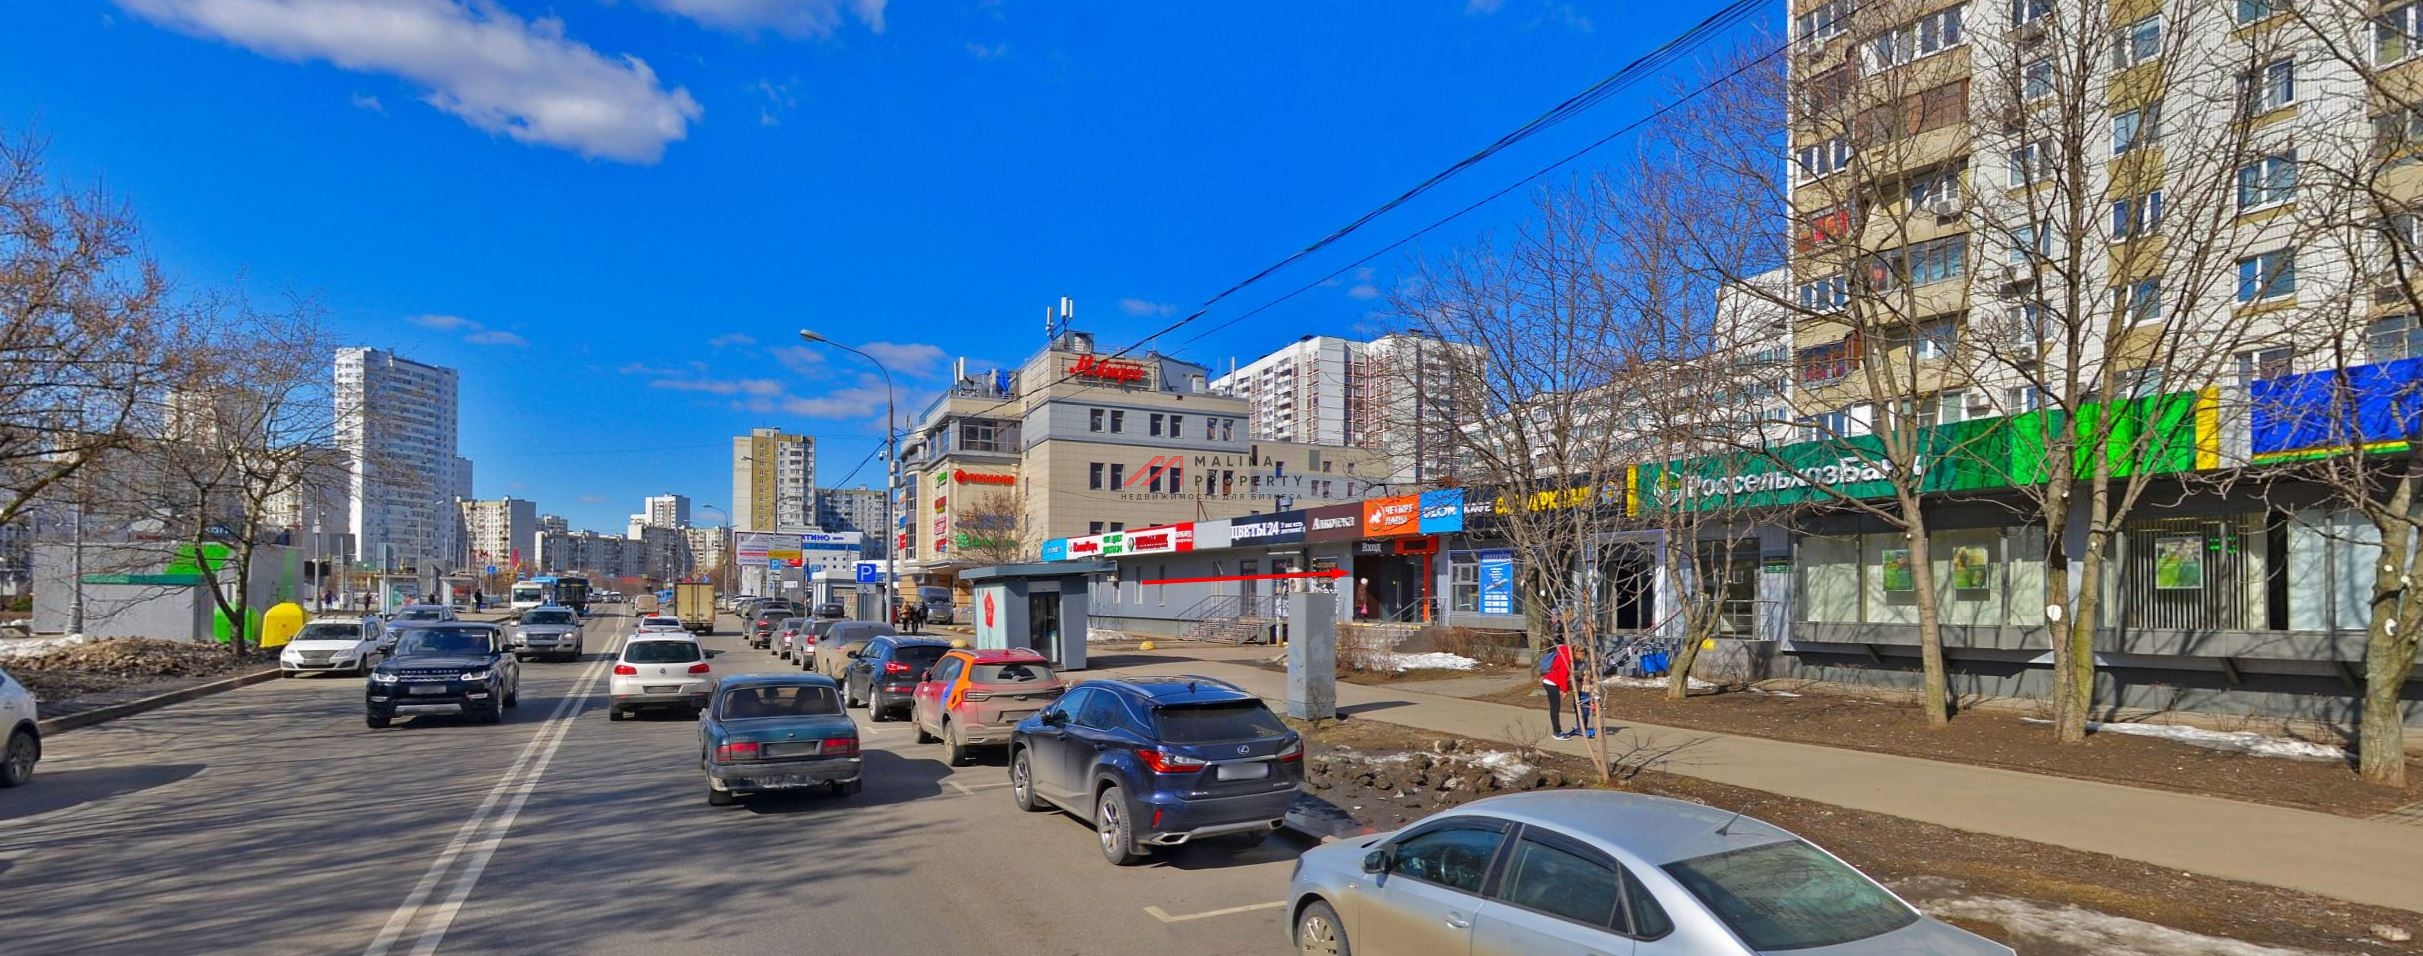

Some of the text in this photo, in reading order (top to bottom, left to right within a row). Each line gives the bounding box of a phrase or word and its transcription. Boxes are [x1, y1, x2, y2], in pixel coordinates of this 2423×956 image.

[1384, 503, 1414, 514] ЧЕТЫРЕ
[1384, 515, 1409, 526] ЛАПЫ
[1362, 542, 1382, 553] Вход
[861, 566, 873, 581] P
